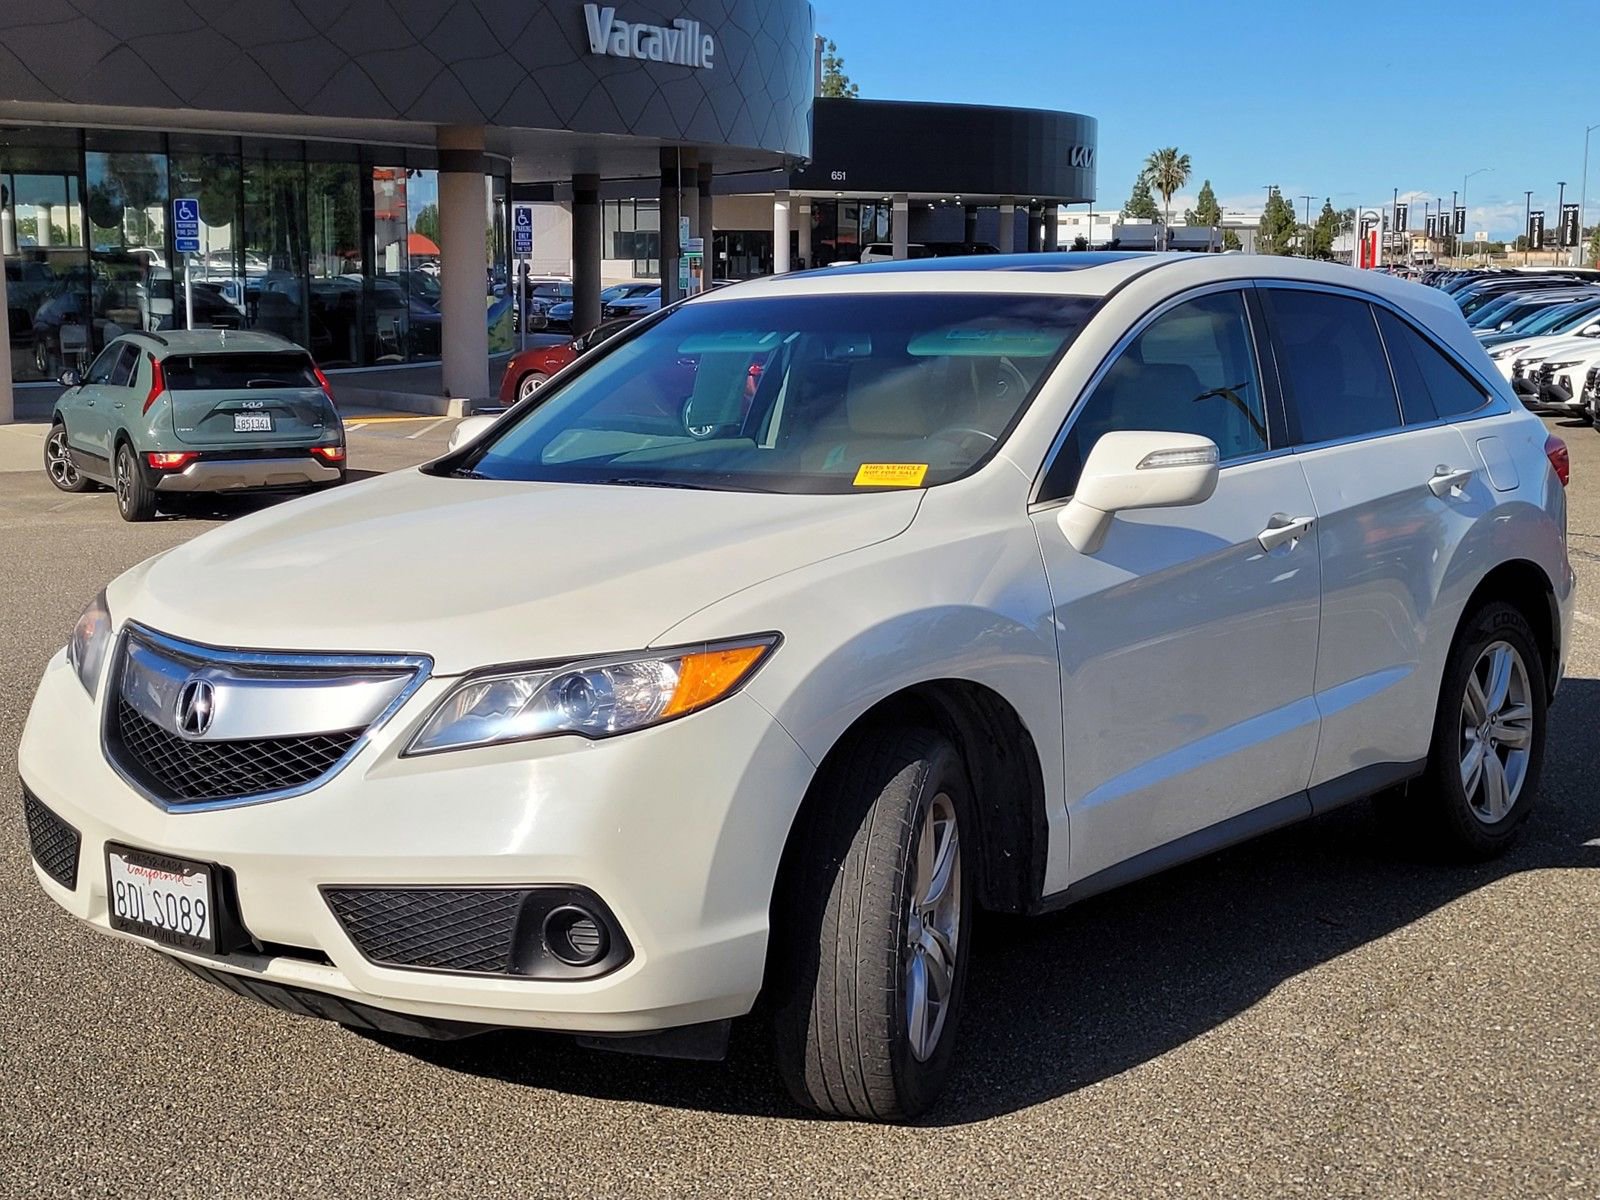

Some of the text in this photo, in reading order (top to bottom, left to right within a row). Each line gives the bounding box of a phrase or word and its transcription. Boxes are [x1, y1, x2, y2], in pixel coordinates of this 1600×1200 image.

[583, 3, 714, 69] Vacaville
[831, 171, 846, 180] 651
[116, 880, 206, 937] 8DLS089
